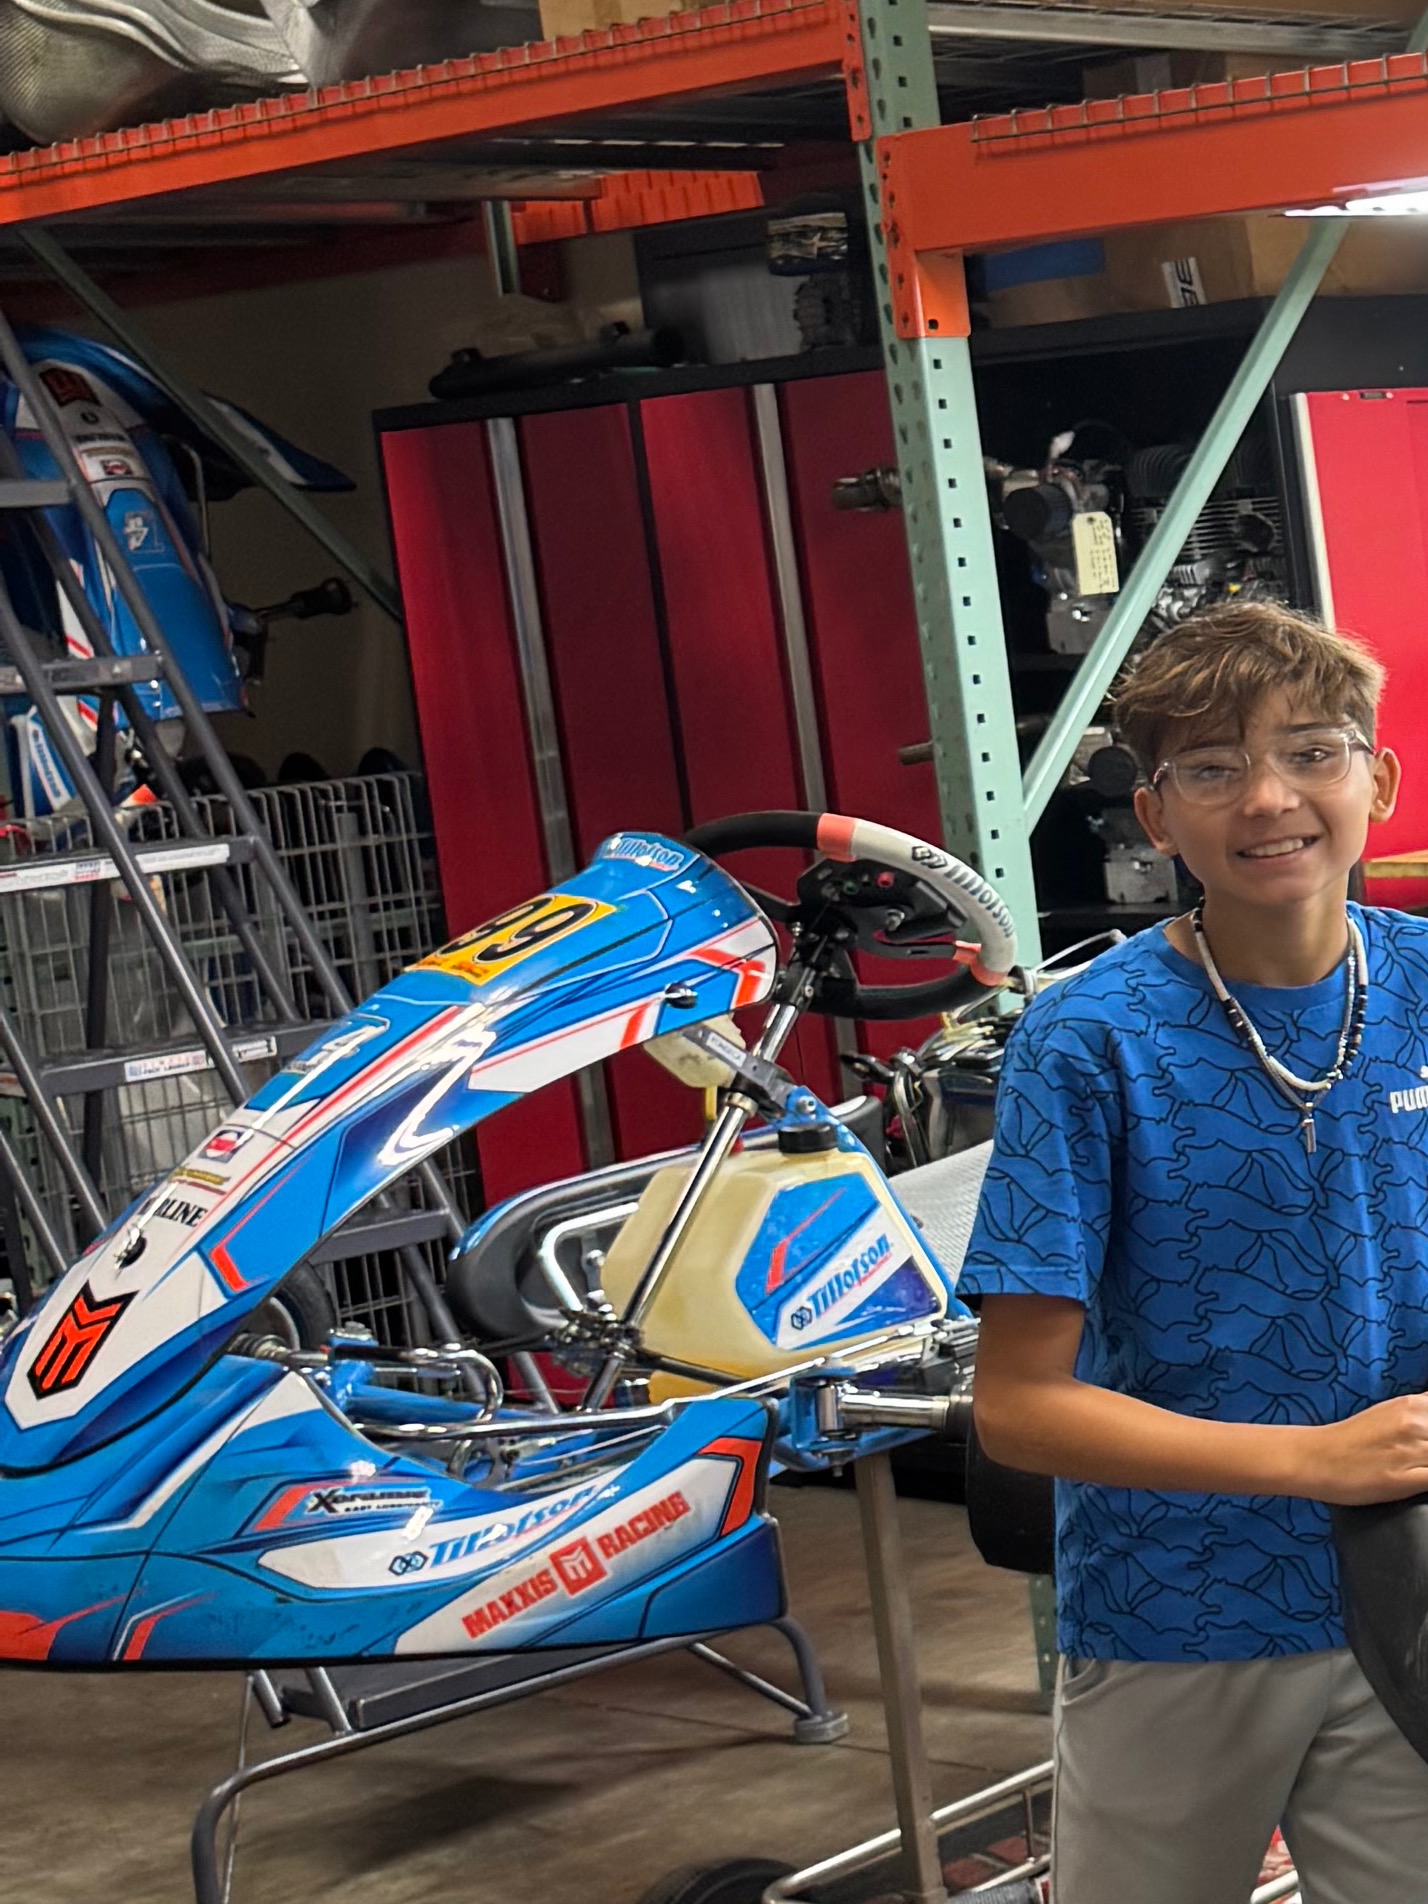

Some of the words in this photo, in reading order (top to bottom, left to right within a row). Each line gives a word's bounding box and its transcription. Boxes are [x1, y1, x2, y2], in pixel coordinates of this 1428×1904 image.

[807, 1232, 891, 1319] Tillotson
[461, 1572, 559, 1640] MAXXIS
[599, 1490, 692, 1559] RACING
